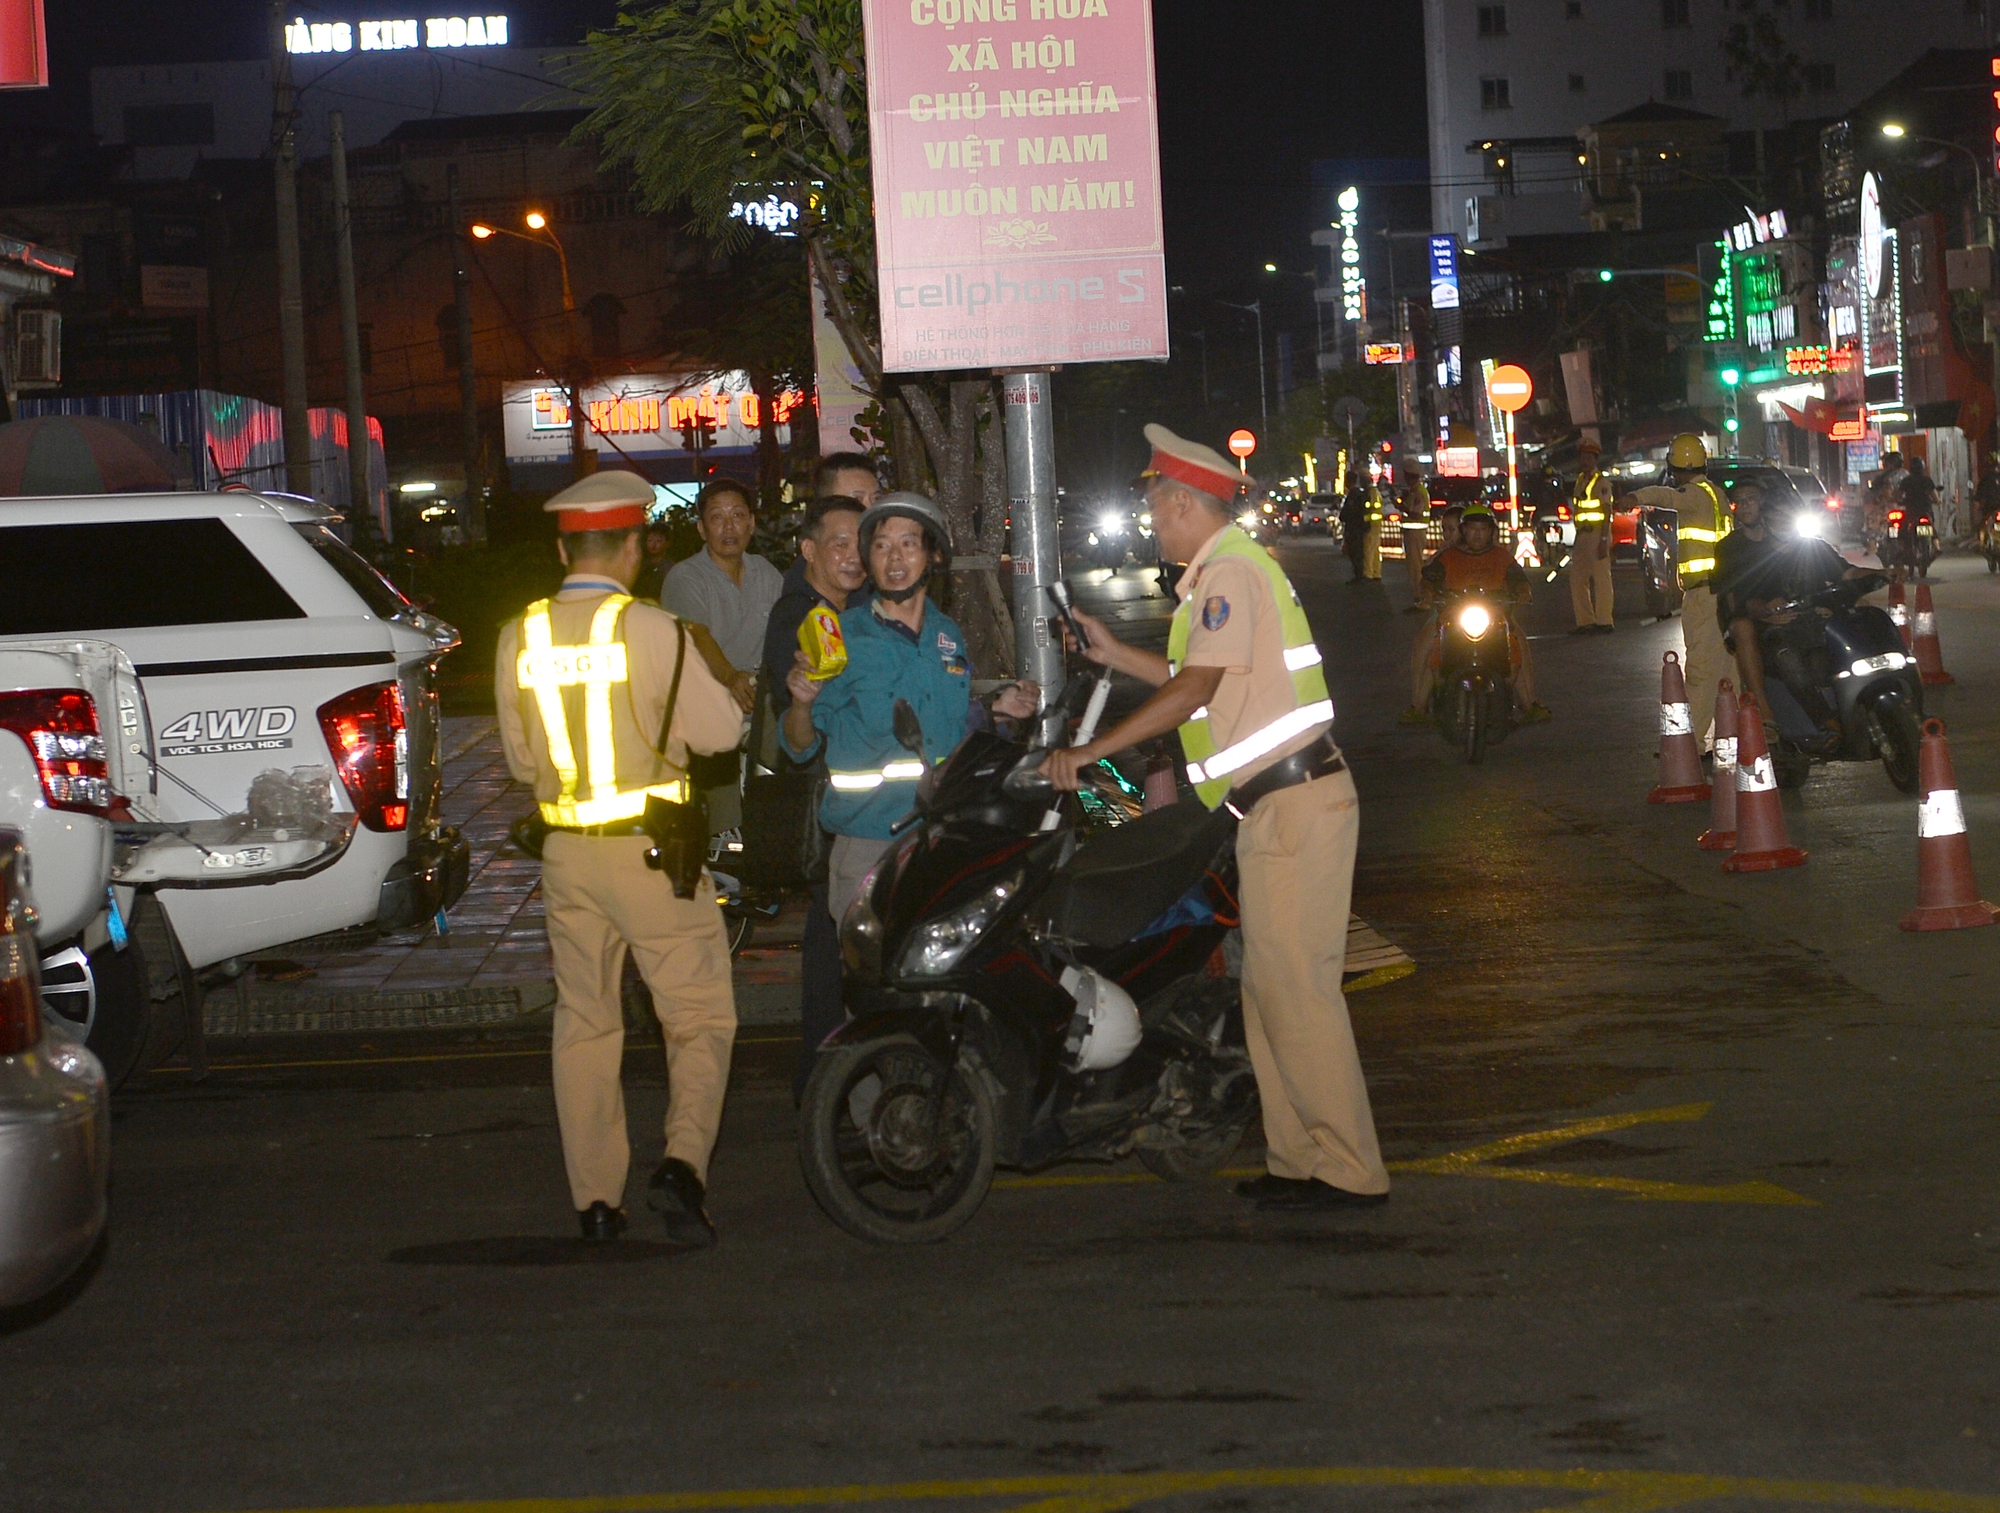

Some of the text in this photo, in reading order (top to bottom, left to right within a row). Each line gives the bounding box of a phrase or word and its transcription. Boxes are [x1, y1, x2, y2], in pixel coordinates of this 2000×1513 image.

[359, 19, 419, 51] KIM
[947, 34, 1076, 74] XÃ HỘI
[909, 80, 1121, 122] CHỦ NGHĨA
[923, 133, 1108, 174] VIỆT NAM
[901, 177, 1136, 219] MUÔN NĂM!
[894, 270, 1105, 316] cellphone
[915, 326, 935, 344] HỆ
[1088, 317, 1131, 334] HÀNG
[1083, 340, 1114, 357] PHỤ
[1117, 335, 1153, 355] KIỆN
[160, 705, 297, 742] 4WD
[169, 739, 285, 756] VDC TCS HSA HDC
